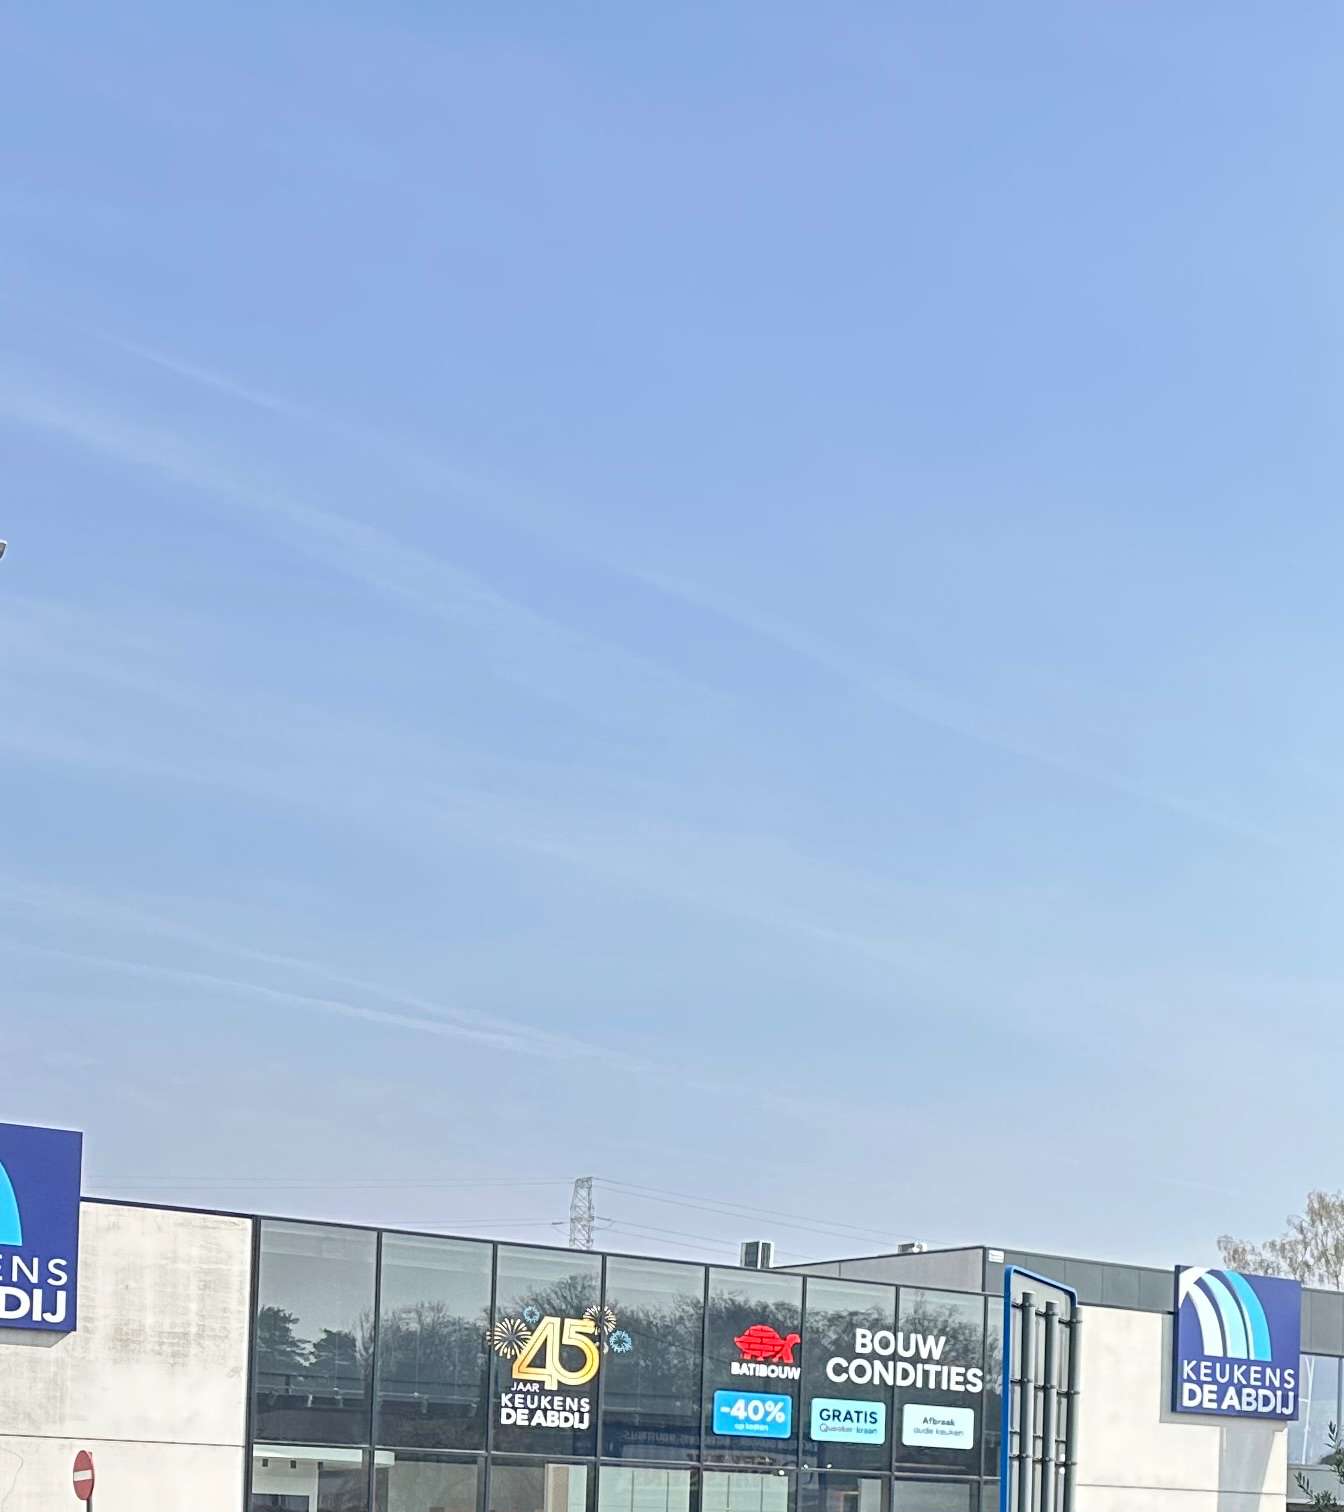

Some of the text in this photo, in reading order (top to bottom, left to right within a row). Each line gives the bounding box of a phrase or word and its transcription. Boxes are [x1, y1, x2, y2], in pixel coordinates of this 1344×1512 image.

[0, 1254, 68, 1286] NS
[511, 1316, 600, 1391] 45
[854, 1328, 946, 1360] BOUW
[731, 1362, 800, 1380] BATIBOUW
[826, 1356, 984, 1393] CONDITIES
[1182, 1360, 1295, 1389] KEUKENS
[511, 1382, 540, 1392] JAAR
[1182, 1382, 1295, 1415] DE ABDIJ
[501, 1393, 590, 1412] KEUKENS
[720, 1399, 786, 1423] -40%
[500, 1408, 590, 1429] DE ABDIJ
[819, 1408, 878, 1424] GRATIS
